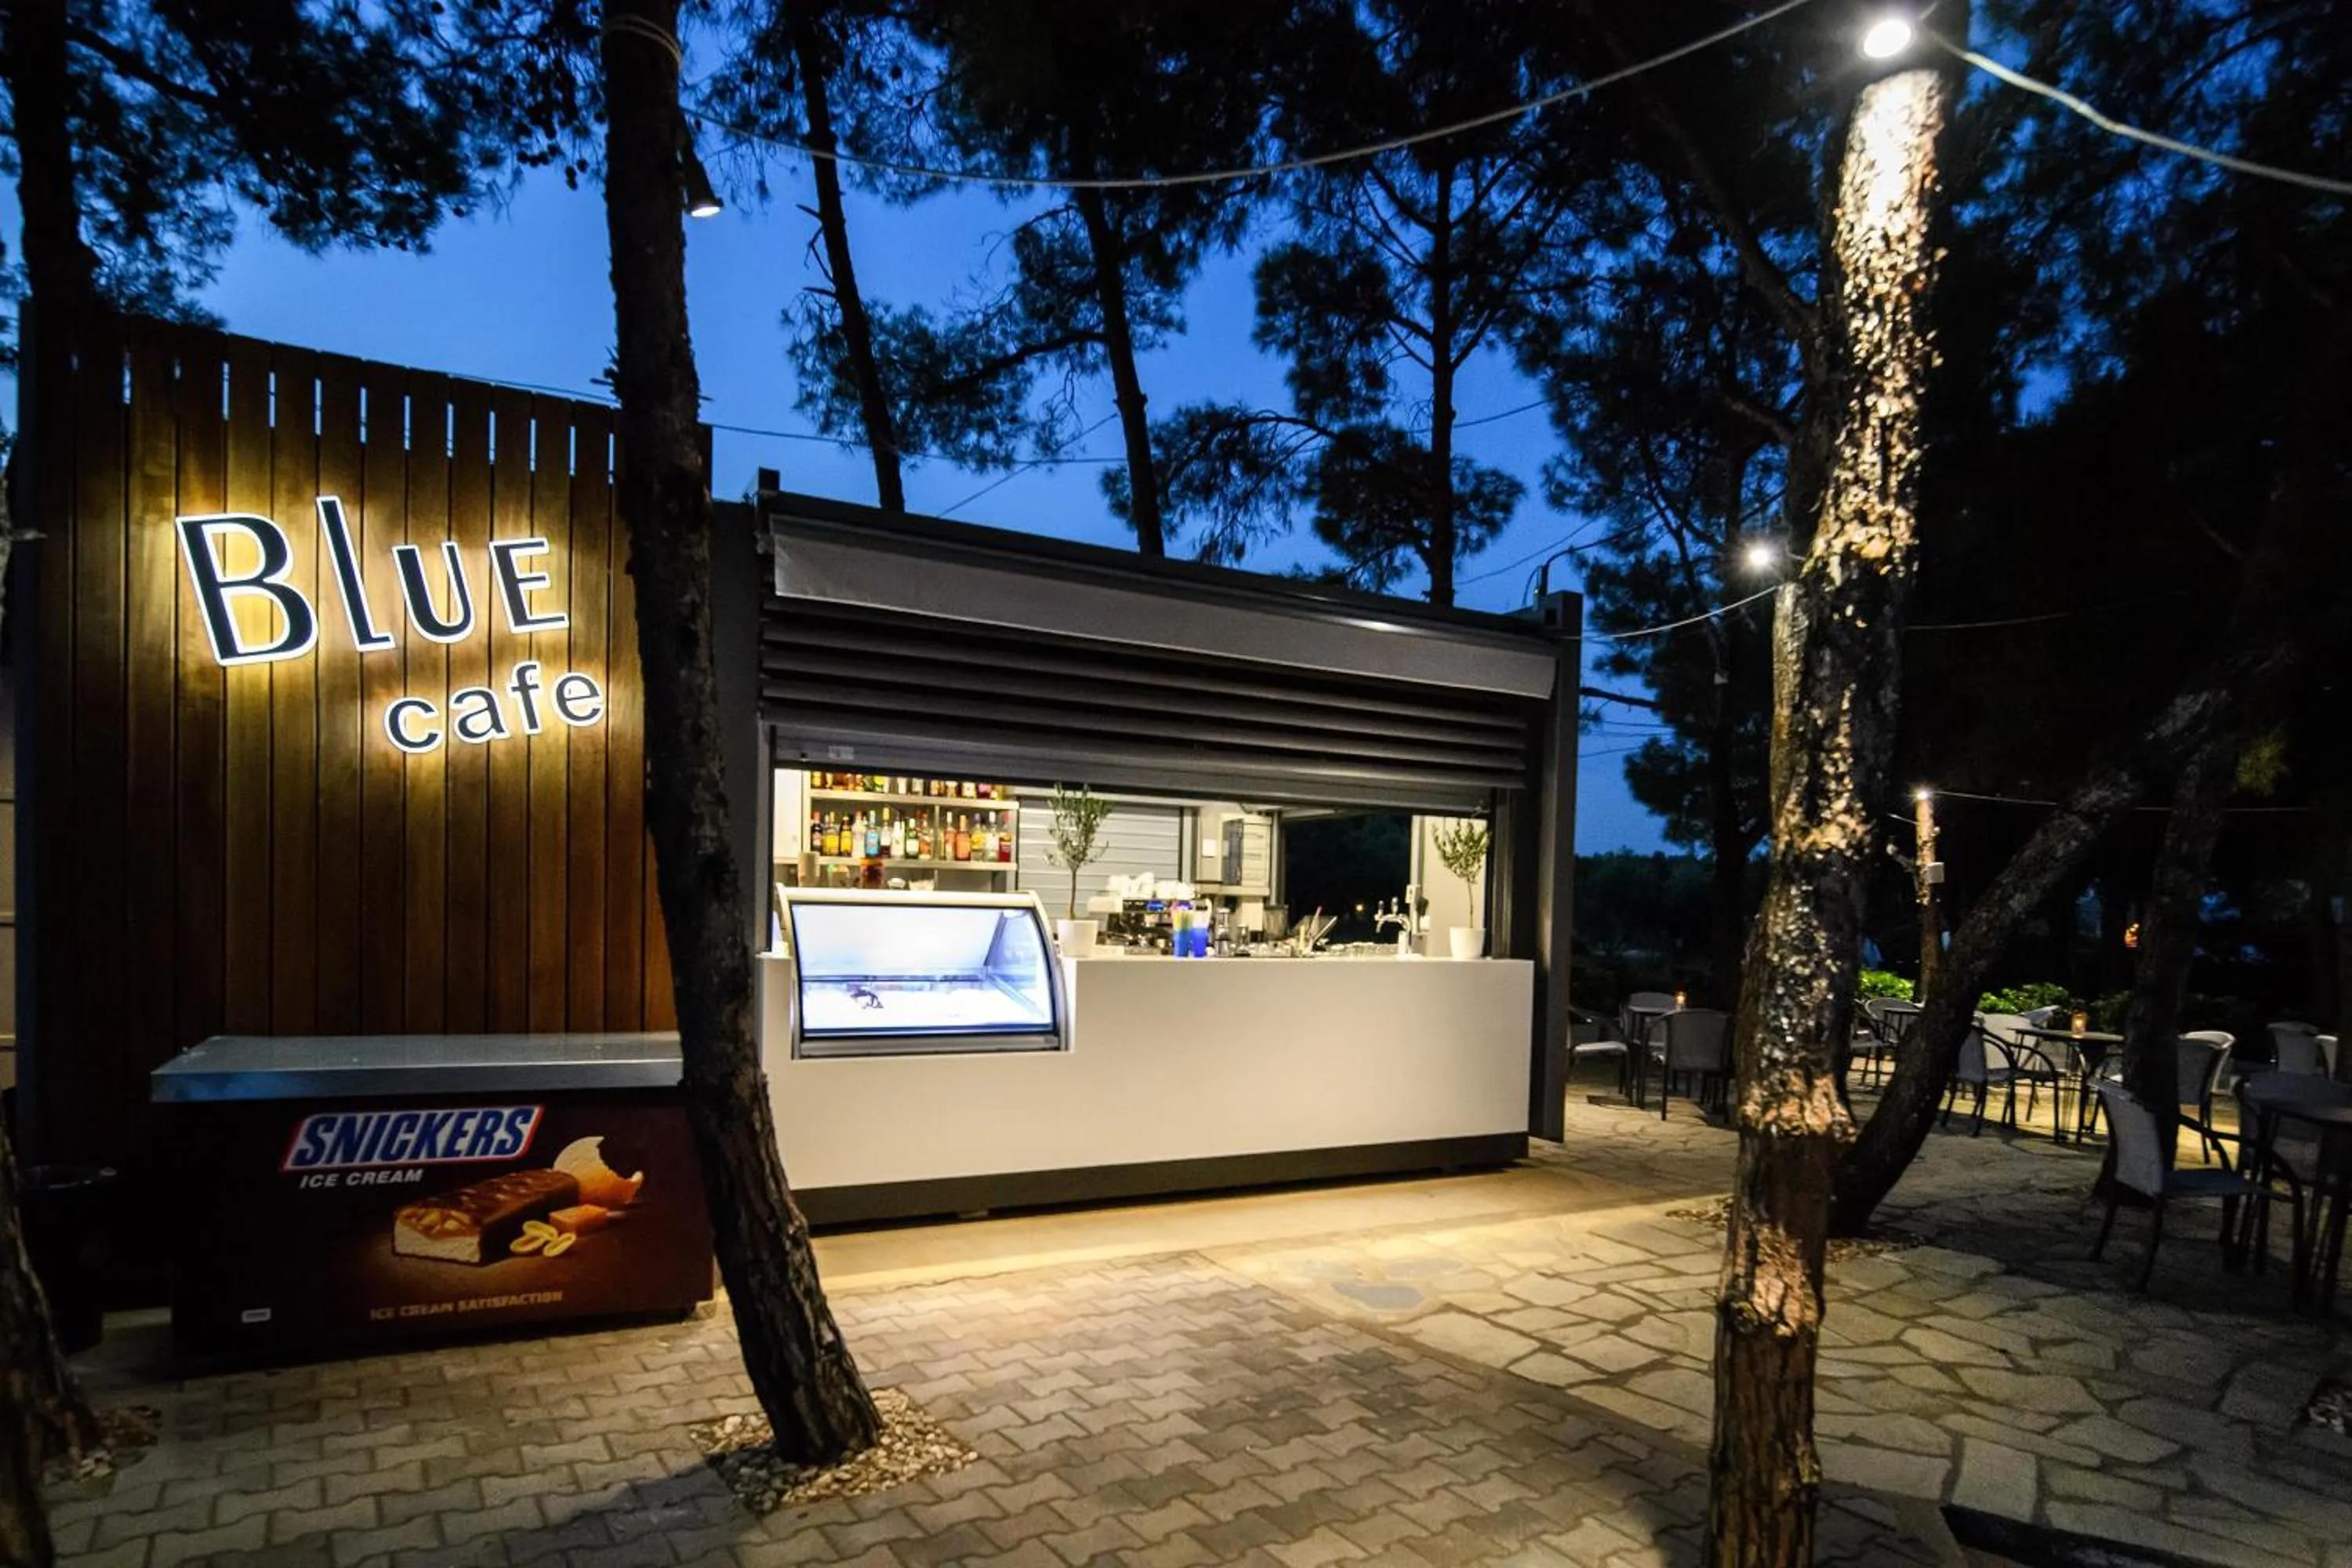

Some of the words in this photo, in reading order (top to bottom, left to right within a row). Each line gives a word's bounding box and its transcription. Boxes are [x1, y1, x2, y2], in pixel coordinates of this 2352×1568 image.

[384, 660, 604, 753] cafe
[291, 1106, 534, 1166] SNICKERS
[299, 1172, 339, 1189] ICE
[345, 1168, 424, 1186] CREAM
[368, 1307, 395, 1321] ICE
[398, 1301, 455, 1318] CREAM
[457, 1290, 564, 1312] SATISFACTION
